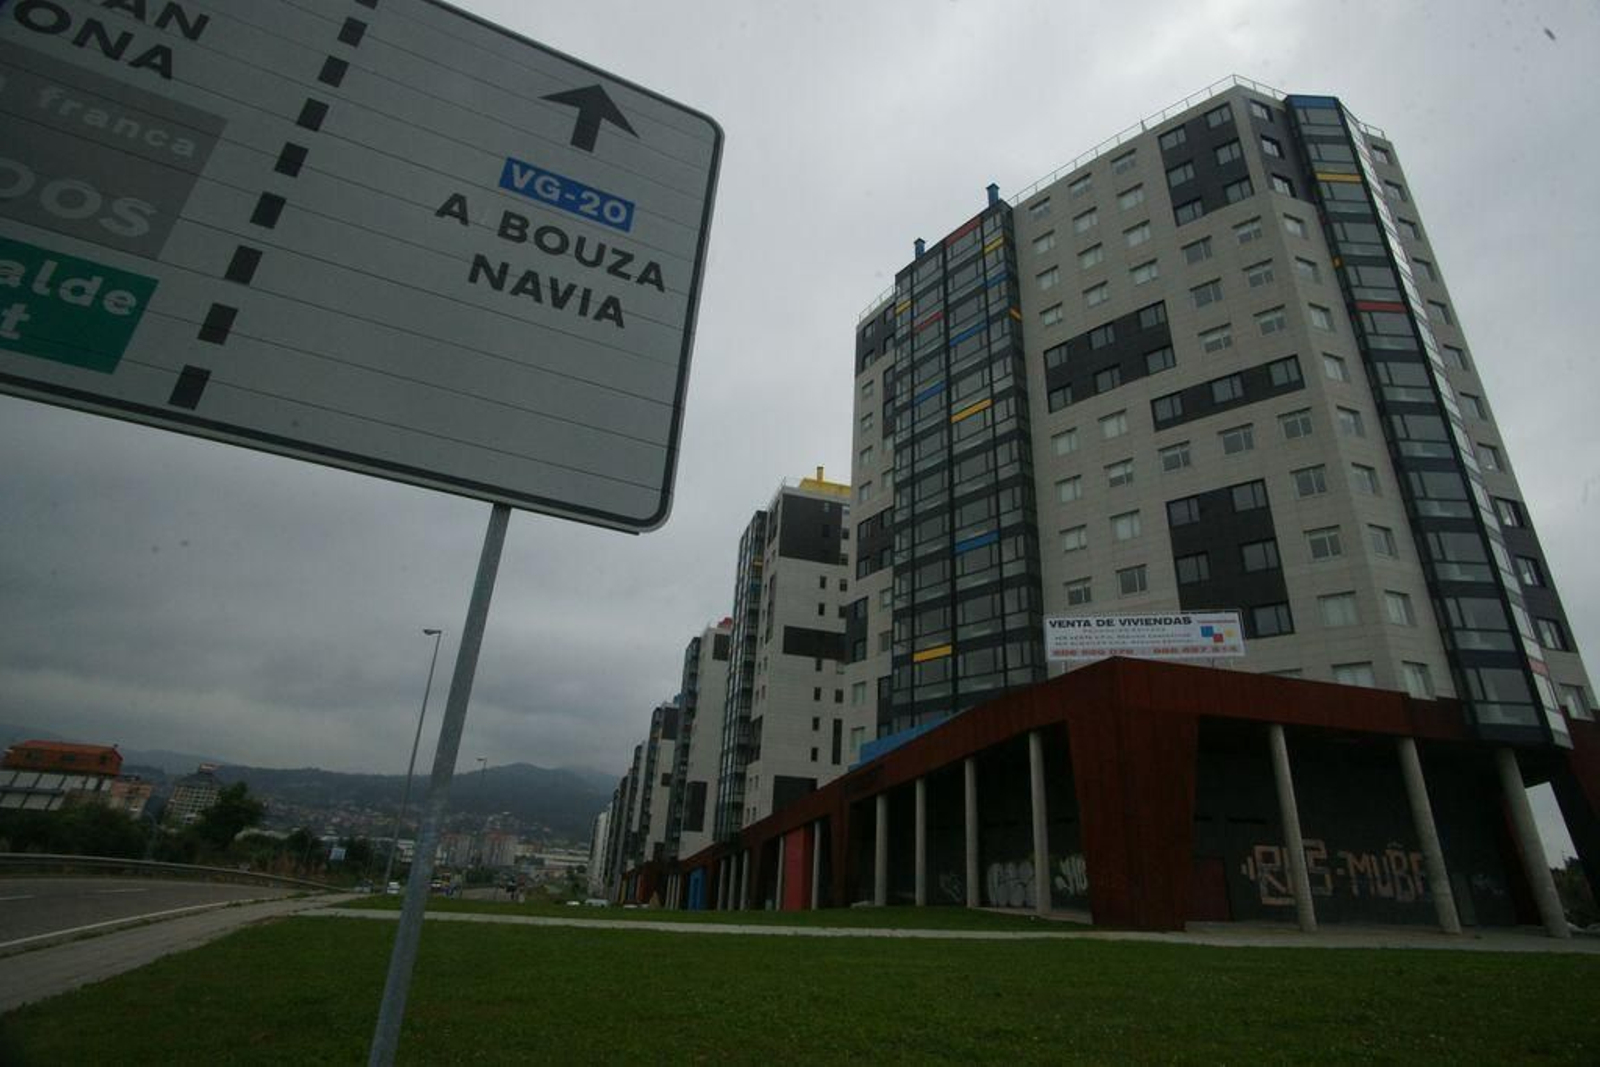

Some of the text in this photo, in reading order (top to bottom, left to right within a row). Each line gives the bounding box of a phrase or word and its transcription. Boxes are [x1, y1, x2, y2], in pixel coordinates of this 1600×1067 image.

[13, 0, 172, 80] ONA
[38, 88, 196, 158] franca
[512, 163, 628, 225] VG-20
[435, 193, 665, 293] A BOUZA
[468, 253, 625, 328] NAVIA
[1049, 619, 1091, 628] VENTA
[1096, 618, 1116, 627] DE
[1119, 616, 1192, 626] VIVIENDAS
